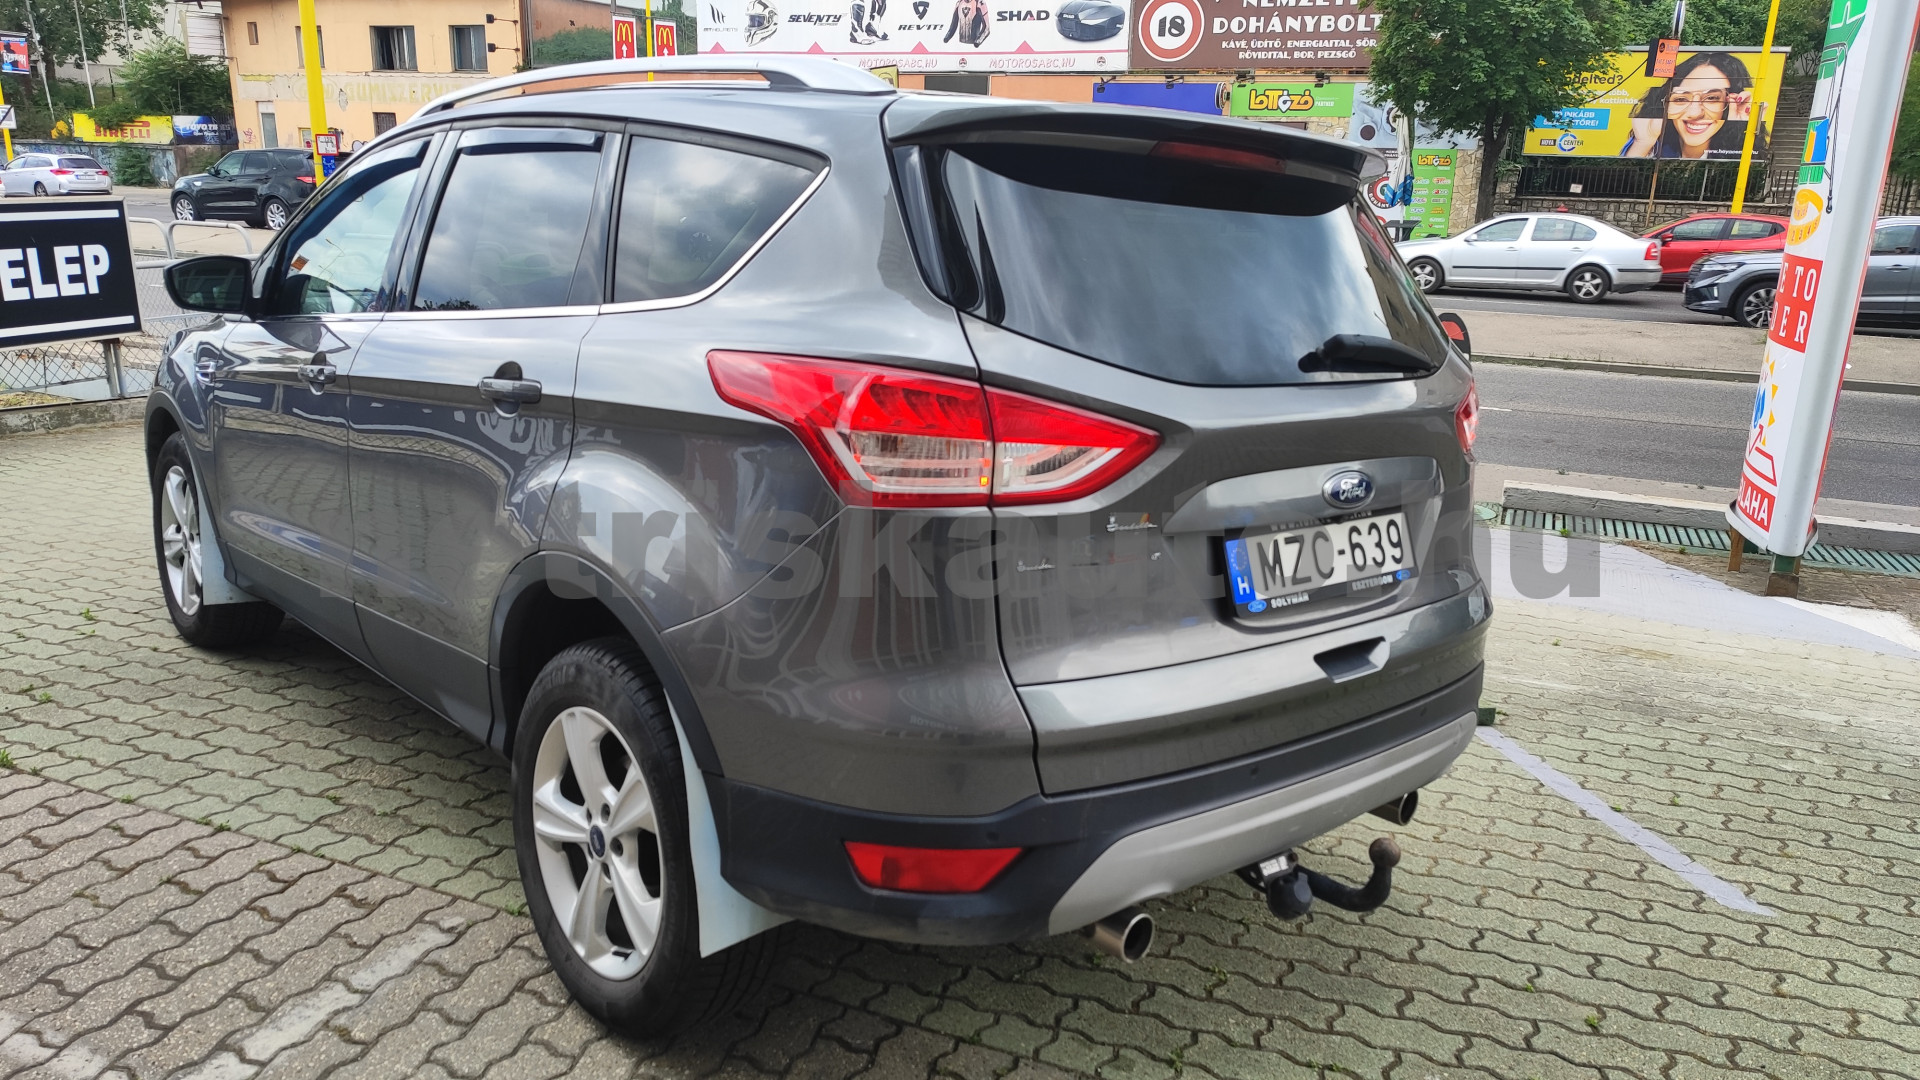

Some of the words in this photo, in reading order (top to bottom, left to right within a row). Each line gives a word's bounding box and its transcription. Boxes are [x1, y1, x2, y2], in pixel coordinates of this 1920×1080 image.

[788, 12, 842, 25] SEVENTY
[996, 10, 1050, 21] SHAD
[1158, 15, 1185, 37] 18
[1318, 48, 1357, 59] PEZSGŐ
[1792, 265, 1817, 302] TO
[1256, 519, 1404, 592] MZC-639
[1237, 577, 1250, 595] H
